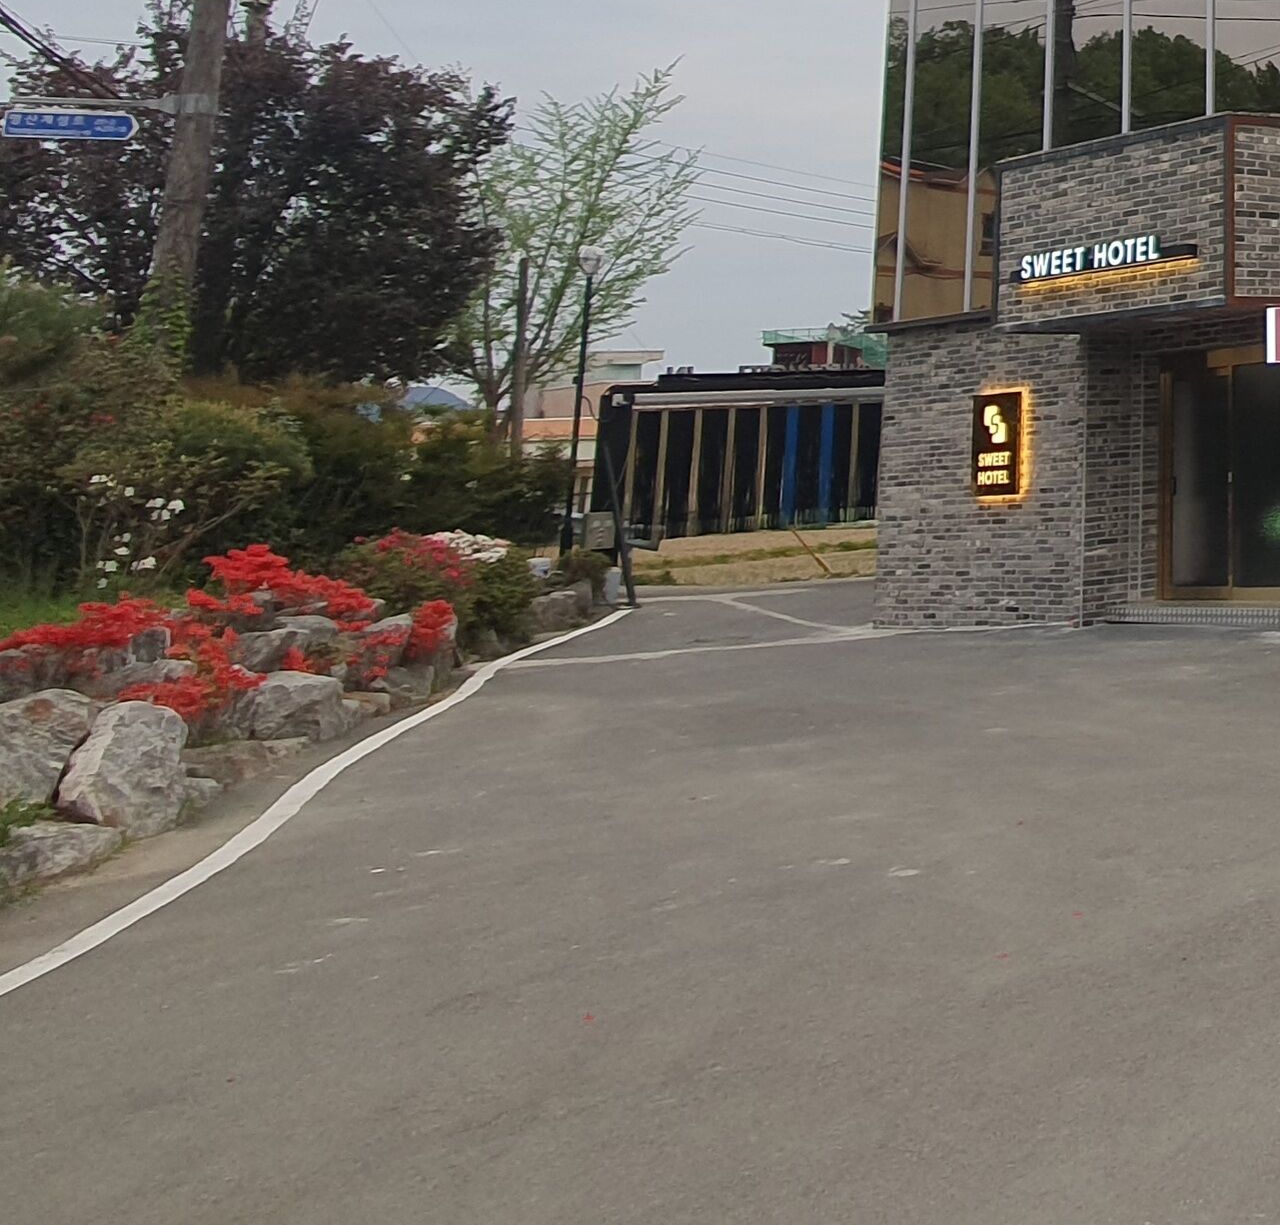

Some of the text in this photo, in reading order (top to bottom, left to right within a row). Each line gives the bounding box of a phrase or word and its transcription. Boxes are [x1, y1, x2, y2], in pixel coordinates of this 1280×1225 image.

[1021, 235, 1160, 279] SWEET HOTEL
[978, 451, 1010, 467] SWEET
[977, 470, 1010, 485] HOTEL
